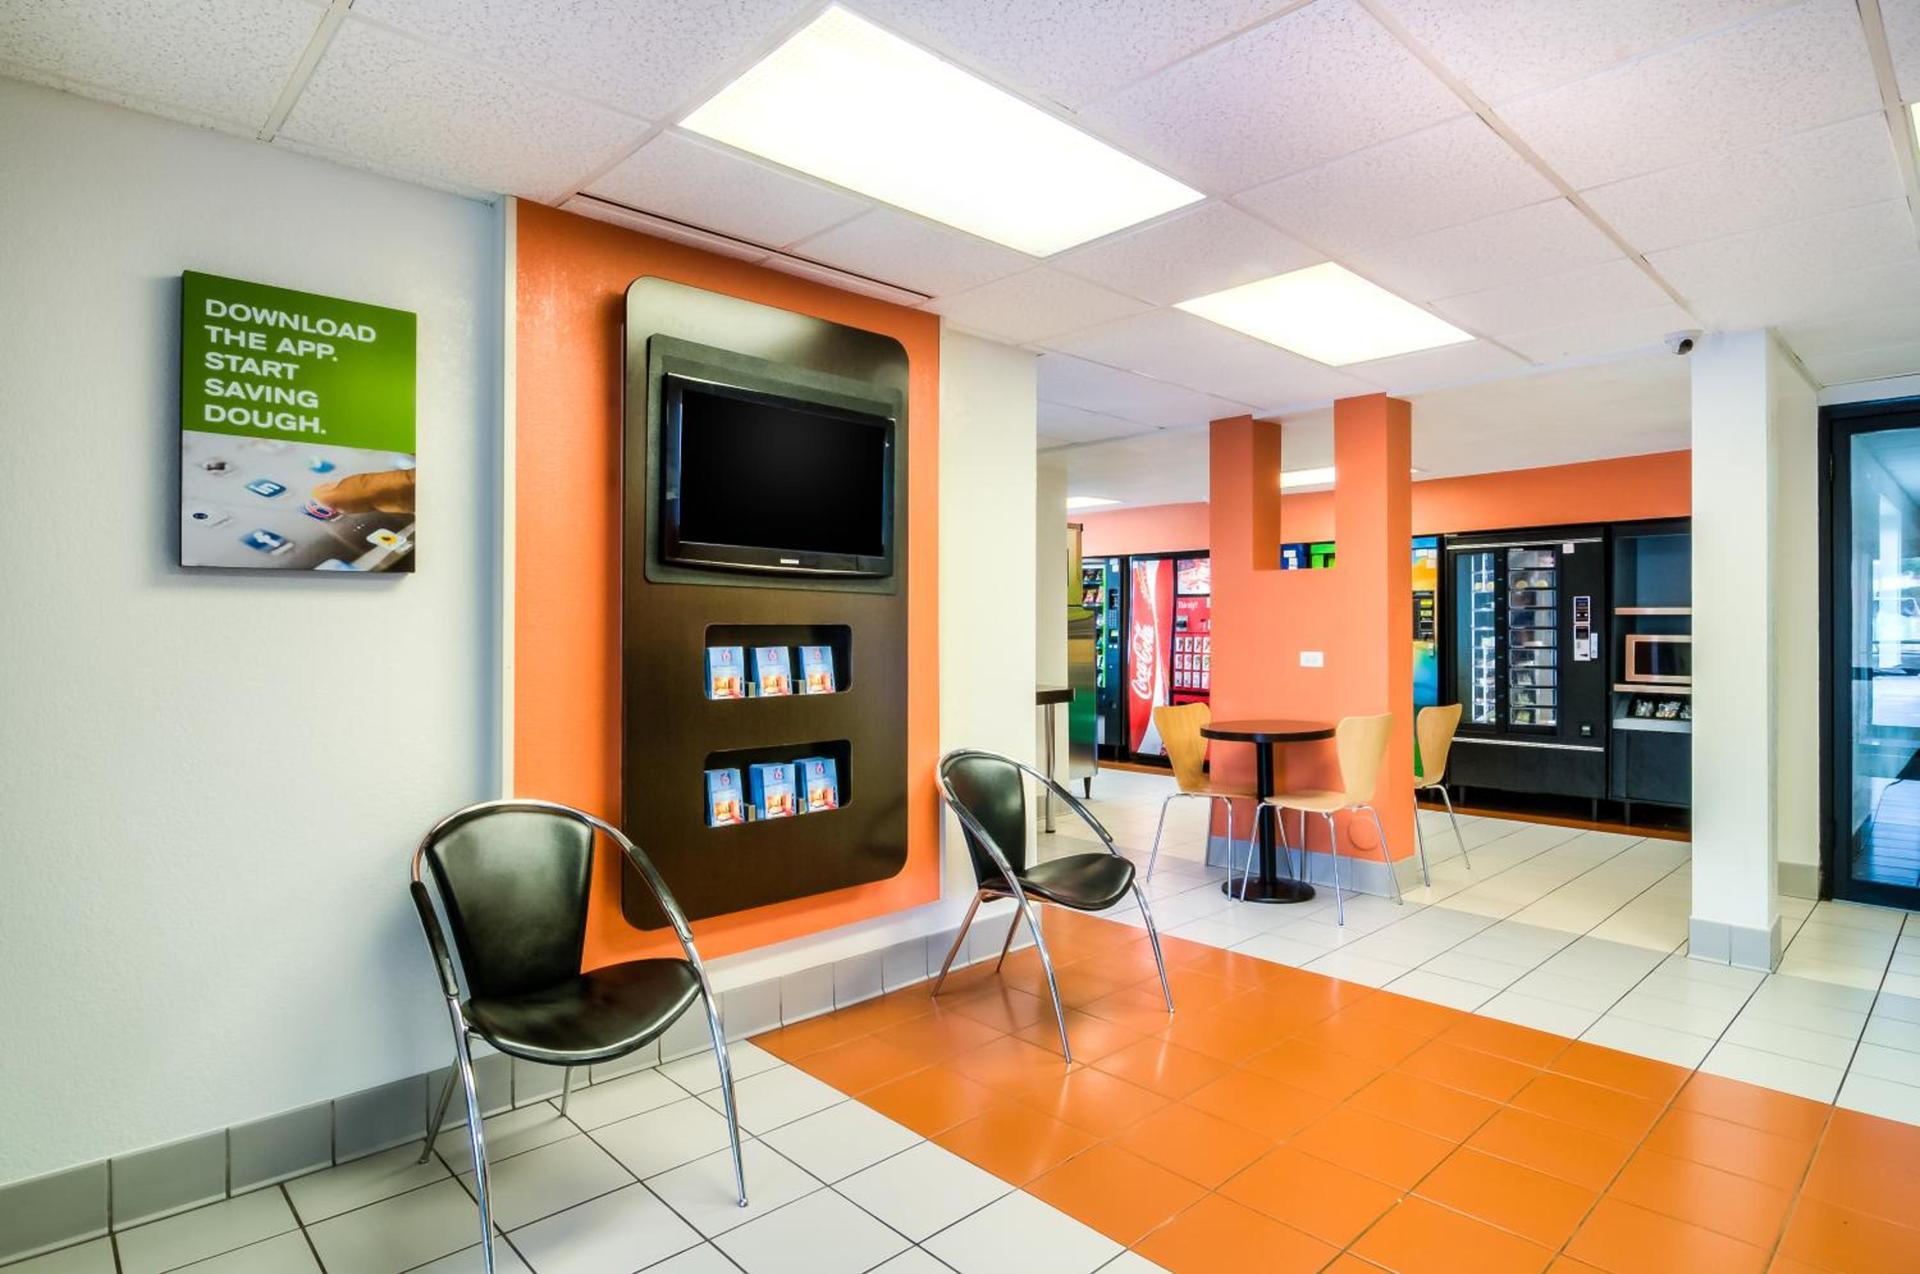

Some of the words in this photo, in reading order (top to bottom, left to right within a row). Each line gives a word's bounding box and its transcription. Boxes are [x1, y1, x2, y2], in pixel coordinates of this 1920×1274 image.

[205, 299, 377, 342] DOWNLOAD
[204, 325, 267, 350] THE
[276, 337, 338, 362] APP.
[204, 352, 299, 380] START
[204, 378, 319, 409] SAVING
[204, 404, 327, 434] DOUGH.
